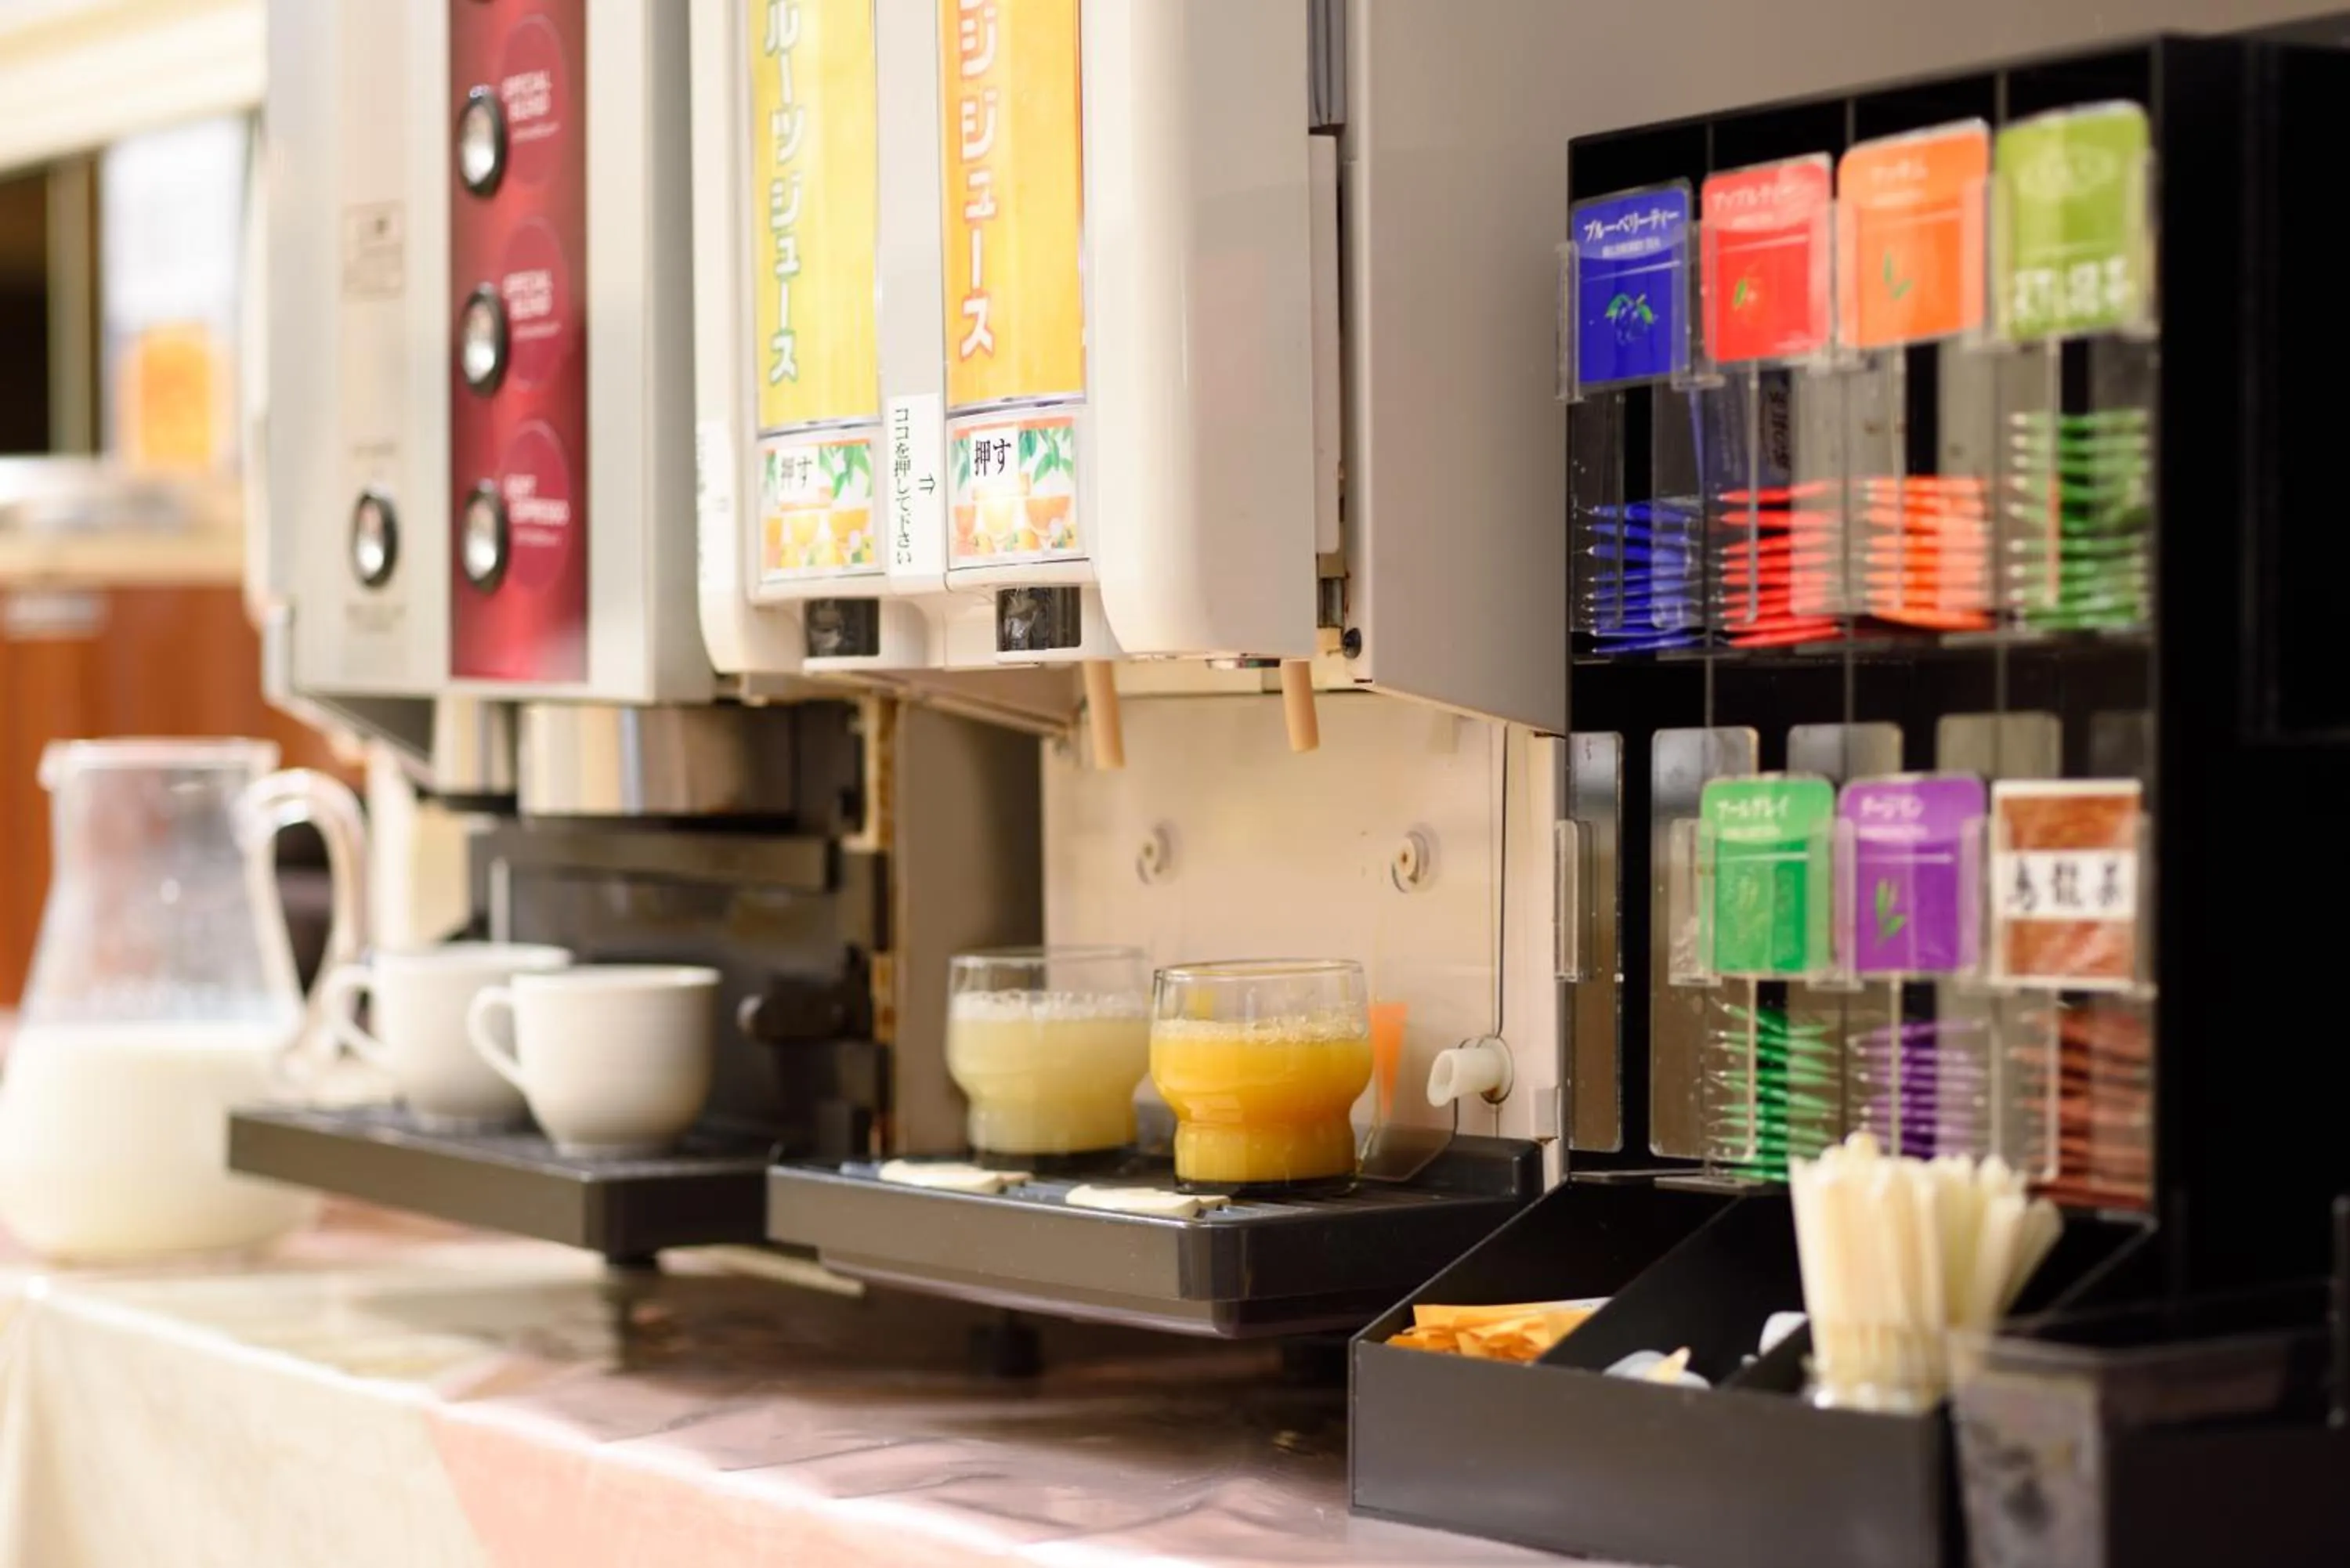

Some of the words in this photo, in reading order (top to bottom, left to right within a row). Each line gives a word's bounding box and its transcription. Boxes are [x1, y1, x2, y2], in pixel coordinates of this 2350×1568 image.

[959, 0, 997, 361] ジジュース
[1583, 208, 1679, 242] ブルーベリーティー
[779, 455, 813, 490] 押す
[974, 438, 1012, 477] 押す
[894, 407, 913, 565] ココを押して下さい
